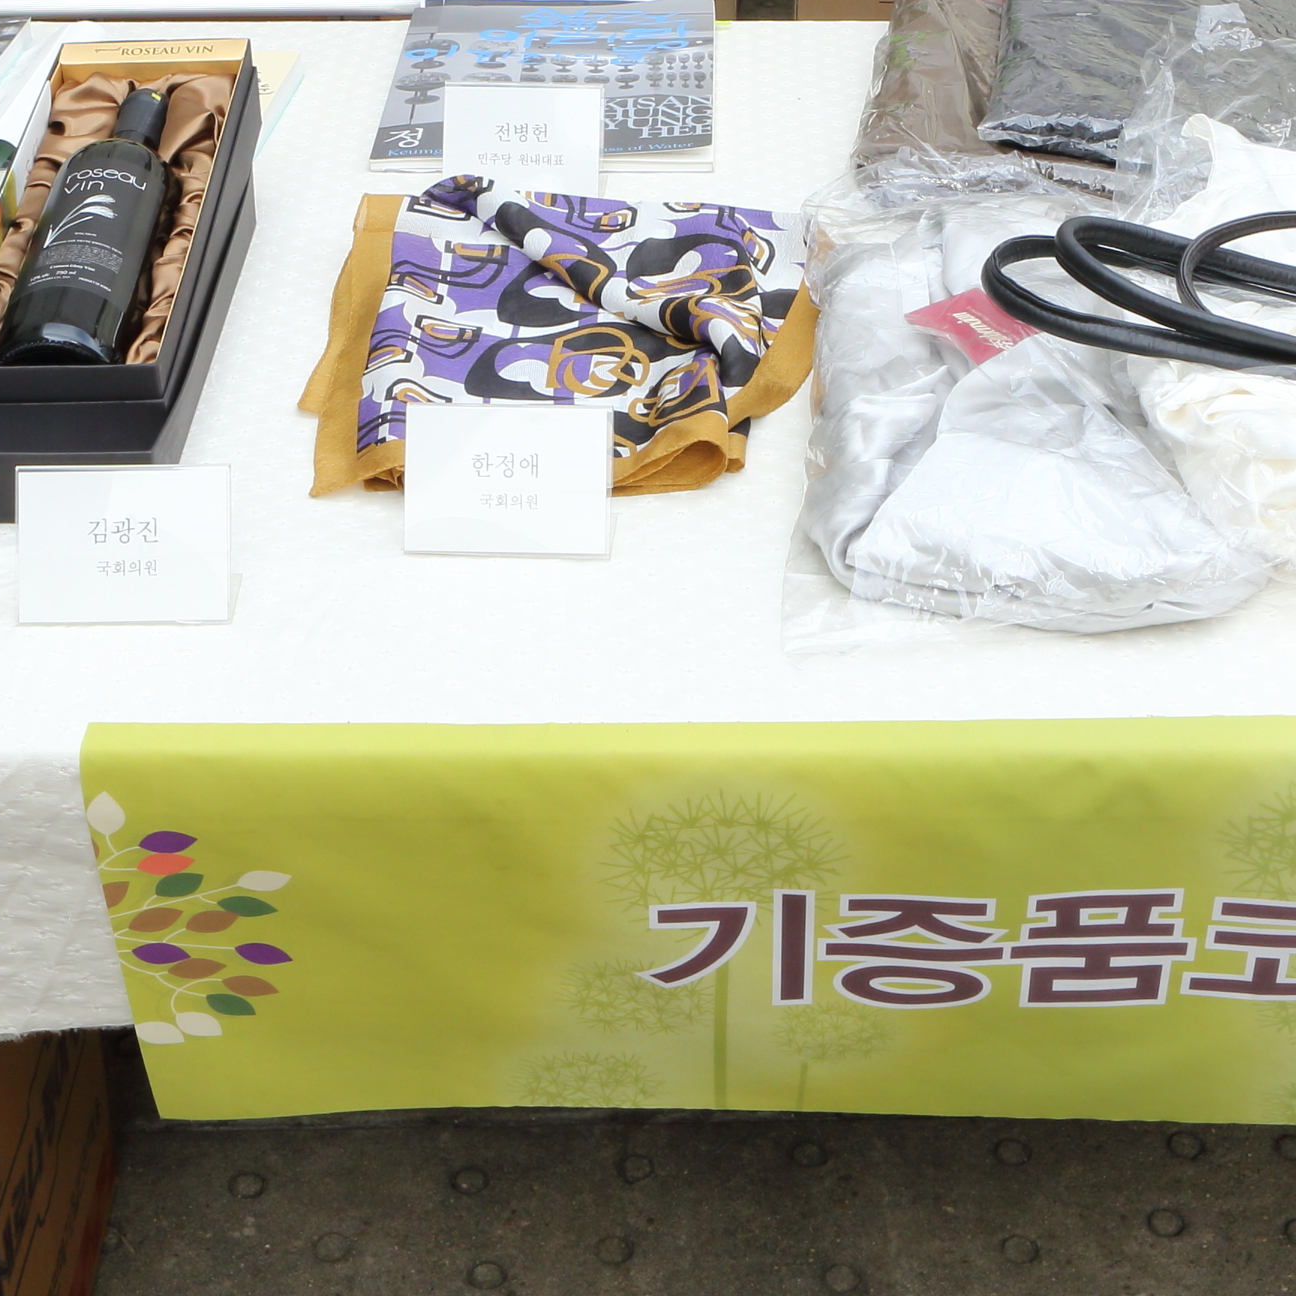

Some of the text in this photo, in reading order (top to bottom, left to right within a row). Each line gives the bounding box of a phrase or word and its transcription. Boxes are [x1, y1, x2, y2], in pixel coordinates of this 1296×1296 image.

[120, 45, 215, 56] ROSEAU VIN
[383, 127, 424, 149] 정
[494, 122, 549, 143] 전병헌
[477, 152, 565, 167] 민주당 원내대표
[64, 180, 104, 194] vin
[66, 168, 147, 191] roseau
[470, 452, 539, 479] 한정애
[480, 493, 539, 510] 국회의원
[87, 517, 159, 545] 김광진
[96, 559, 158, 577] 국회의원
